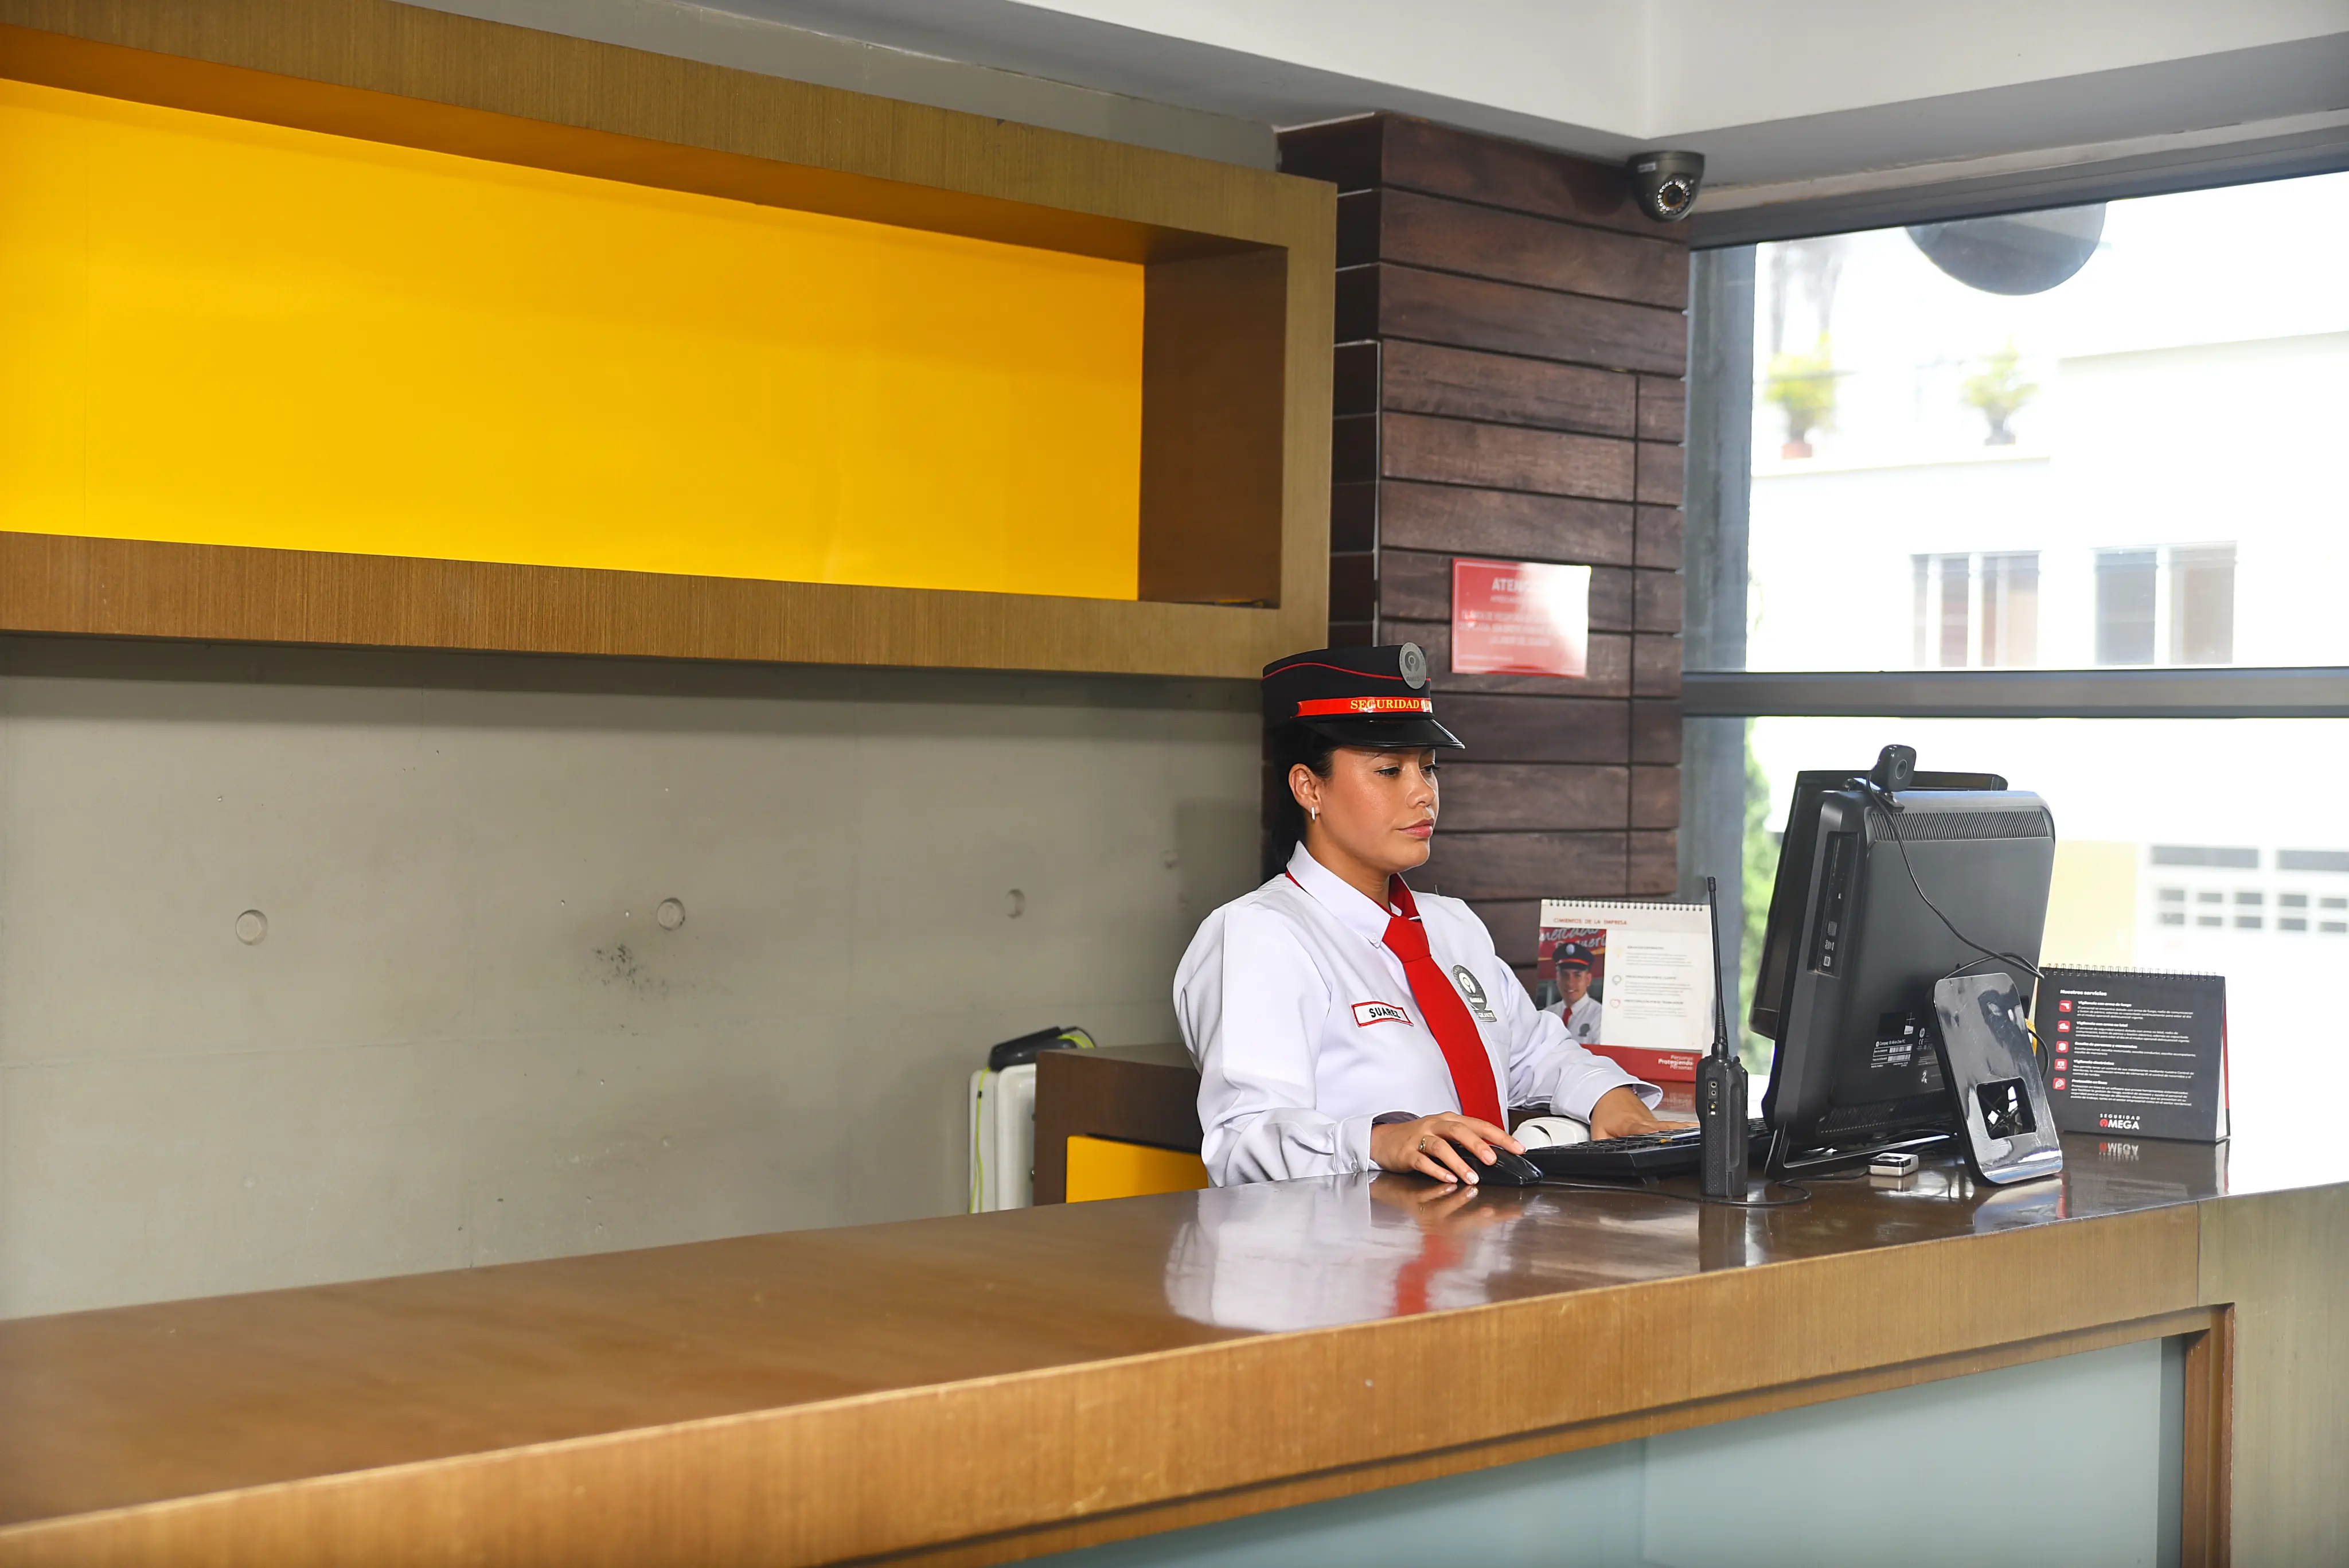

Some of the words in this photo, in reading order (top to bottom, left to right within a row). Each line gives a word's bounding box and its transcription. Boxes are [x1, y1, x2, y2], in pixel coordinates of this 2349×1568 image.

[1350, 699, 1419, 710] SEGURIDAD
[1369, 1008, 1401, 1019] SUAREZ
[1658, 1058, 1693, 1066] Protegiendo
[2099, 1118, 2140, 1130] OMEGA
